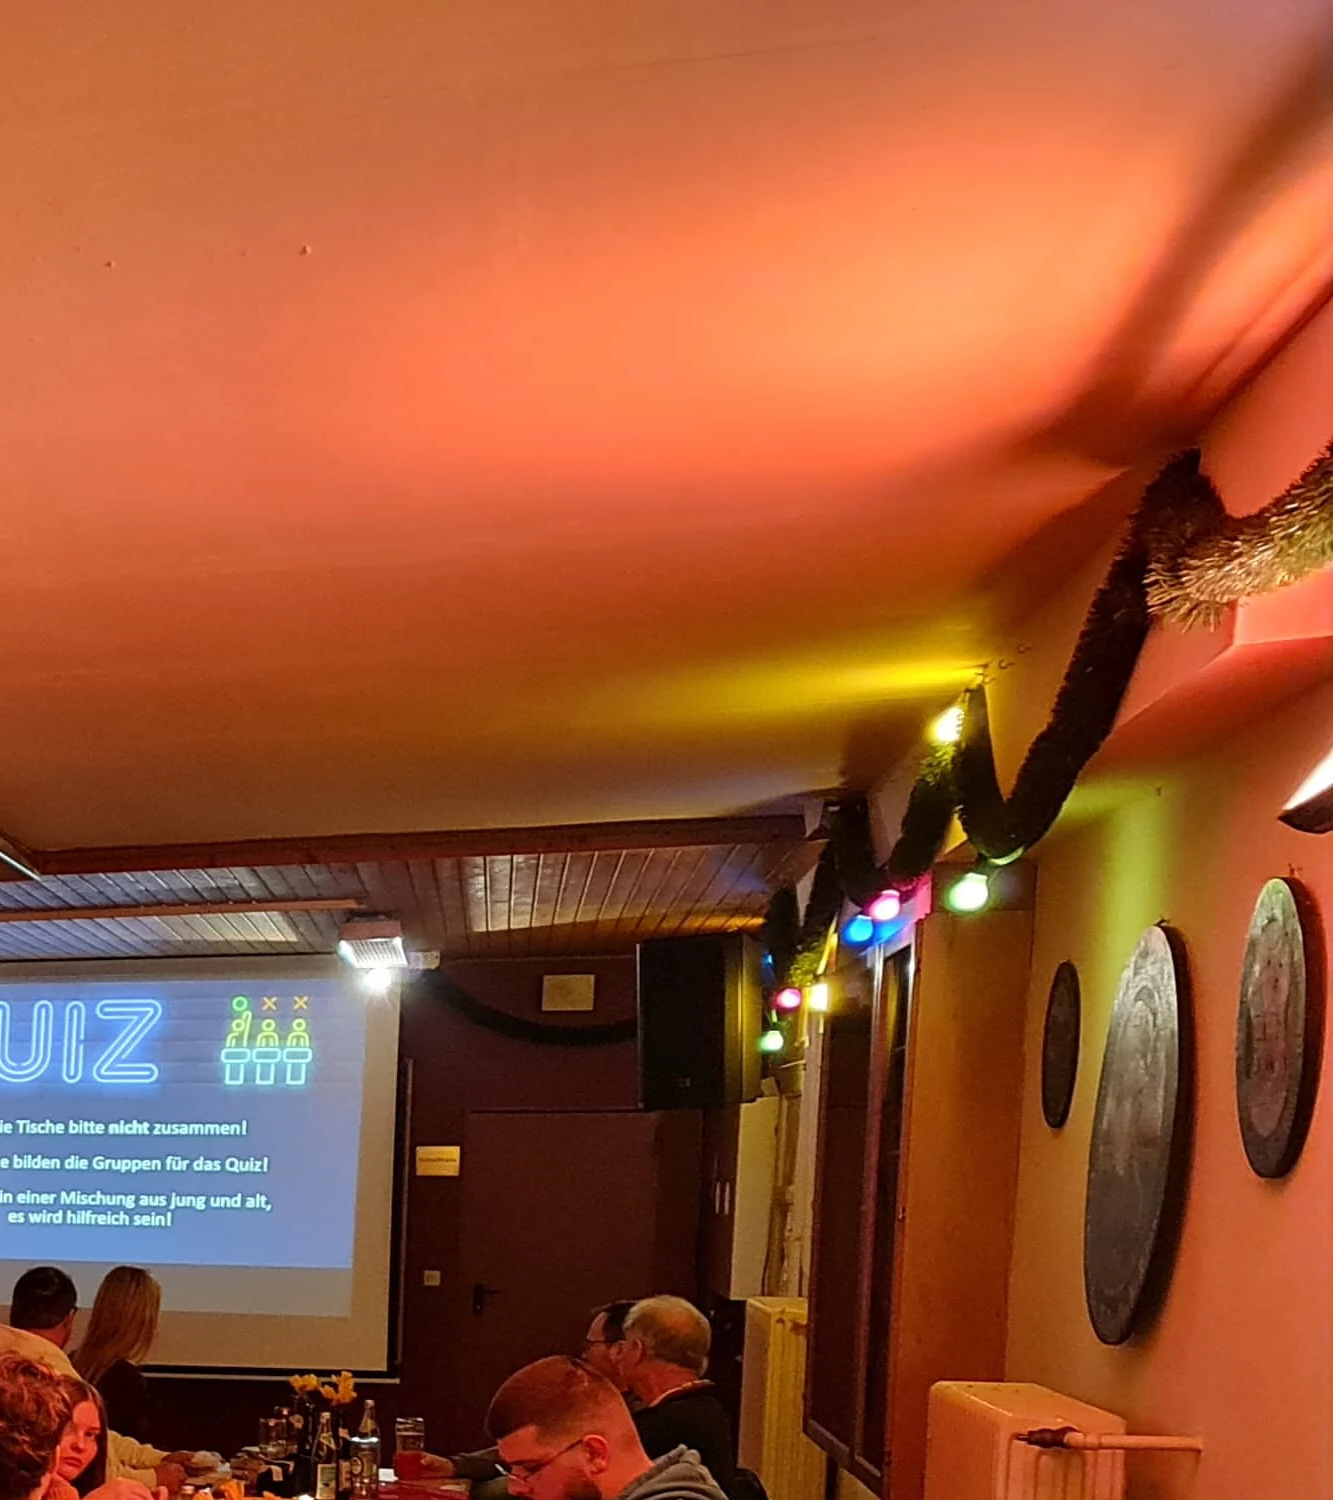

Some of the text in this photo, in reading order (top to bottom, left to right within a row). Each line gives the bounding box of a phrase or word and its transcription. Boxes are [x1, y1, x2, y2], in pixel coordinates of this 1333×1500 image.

[15, 1119, 66, 1134] Tische
[68, 1119, 106, 1135] bitte
[108, 1119, 150, 1135] nicht
[152, 1119, 247, 1136] zusammen!
[12, 1154, 61, 1169] bilden
[64, 1155, 89, 1170] die
[92, 1155, 162, 1173] Gruppen
[165, 1155, 190, 1171] für
[192, 1156, 222, 1172] das
[224, 1156, 269, 1173] Quiz!
[16, 1189, 58, 1205] einer
[60, 1190, 136, 1209] Mischung
[138, 1195, 167, 1207] aus
[169, 1192, 207, 1210] jung
[209, 1192, 242, 1208] und
[245, 1193, 272, 1212] alt,
[7, 1209, 172, 1227] es wird hilfreich sein!
